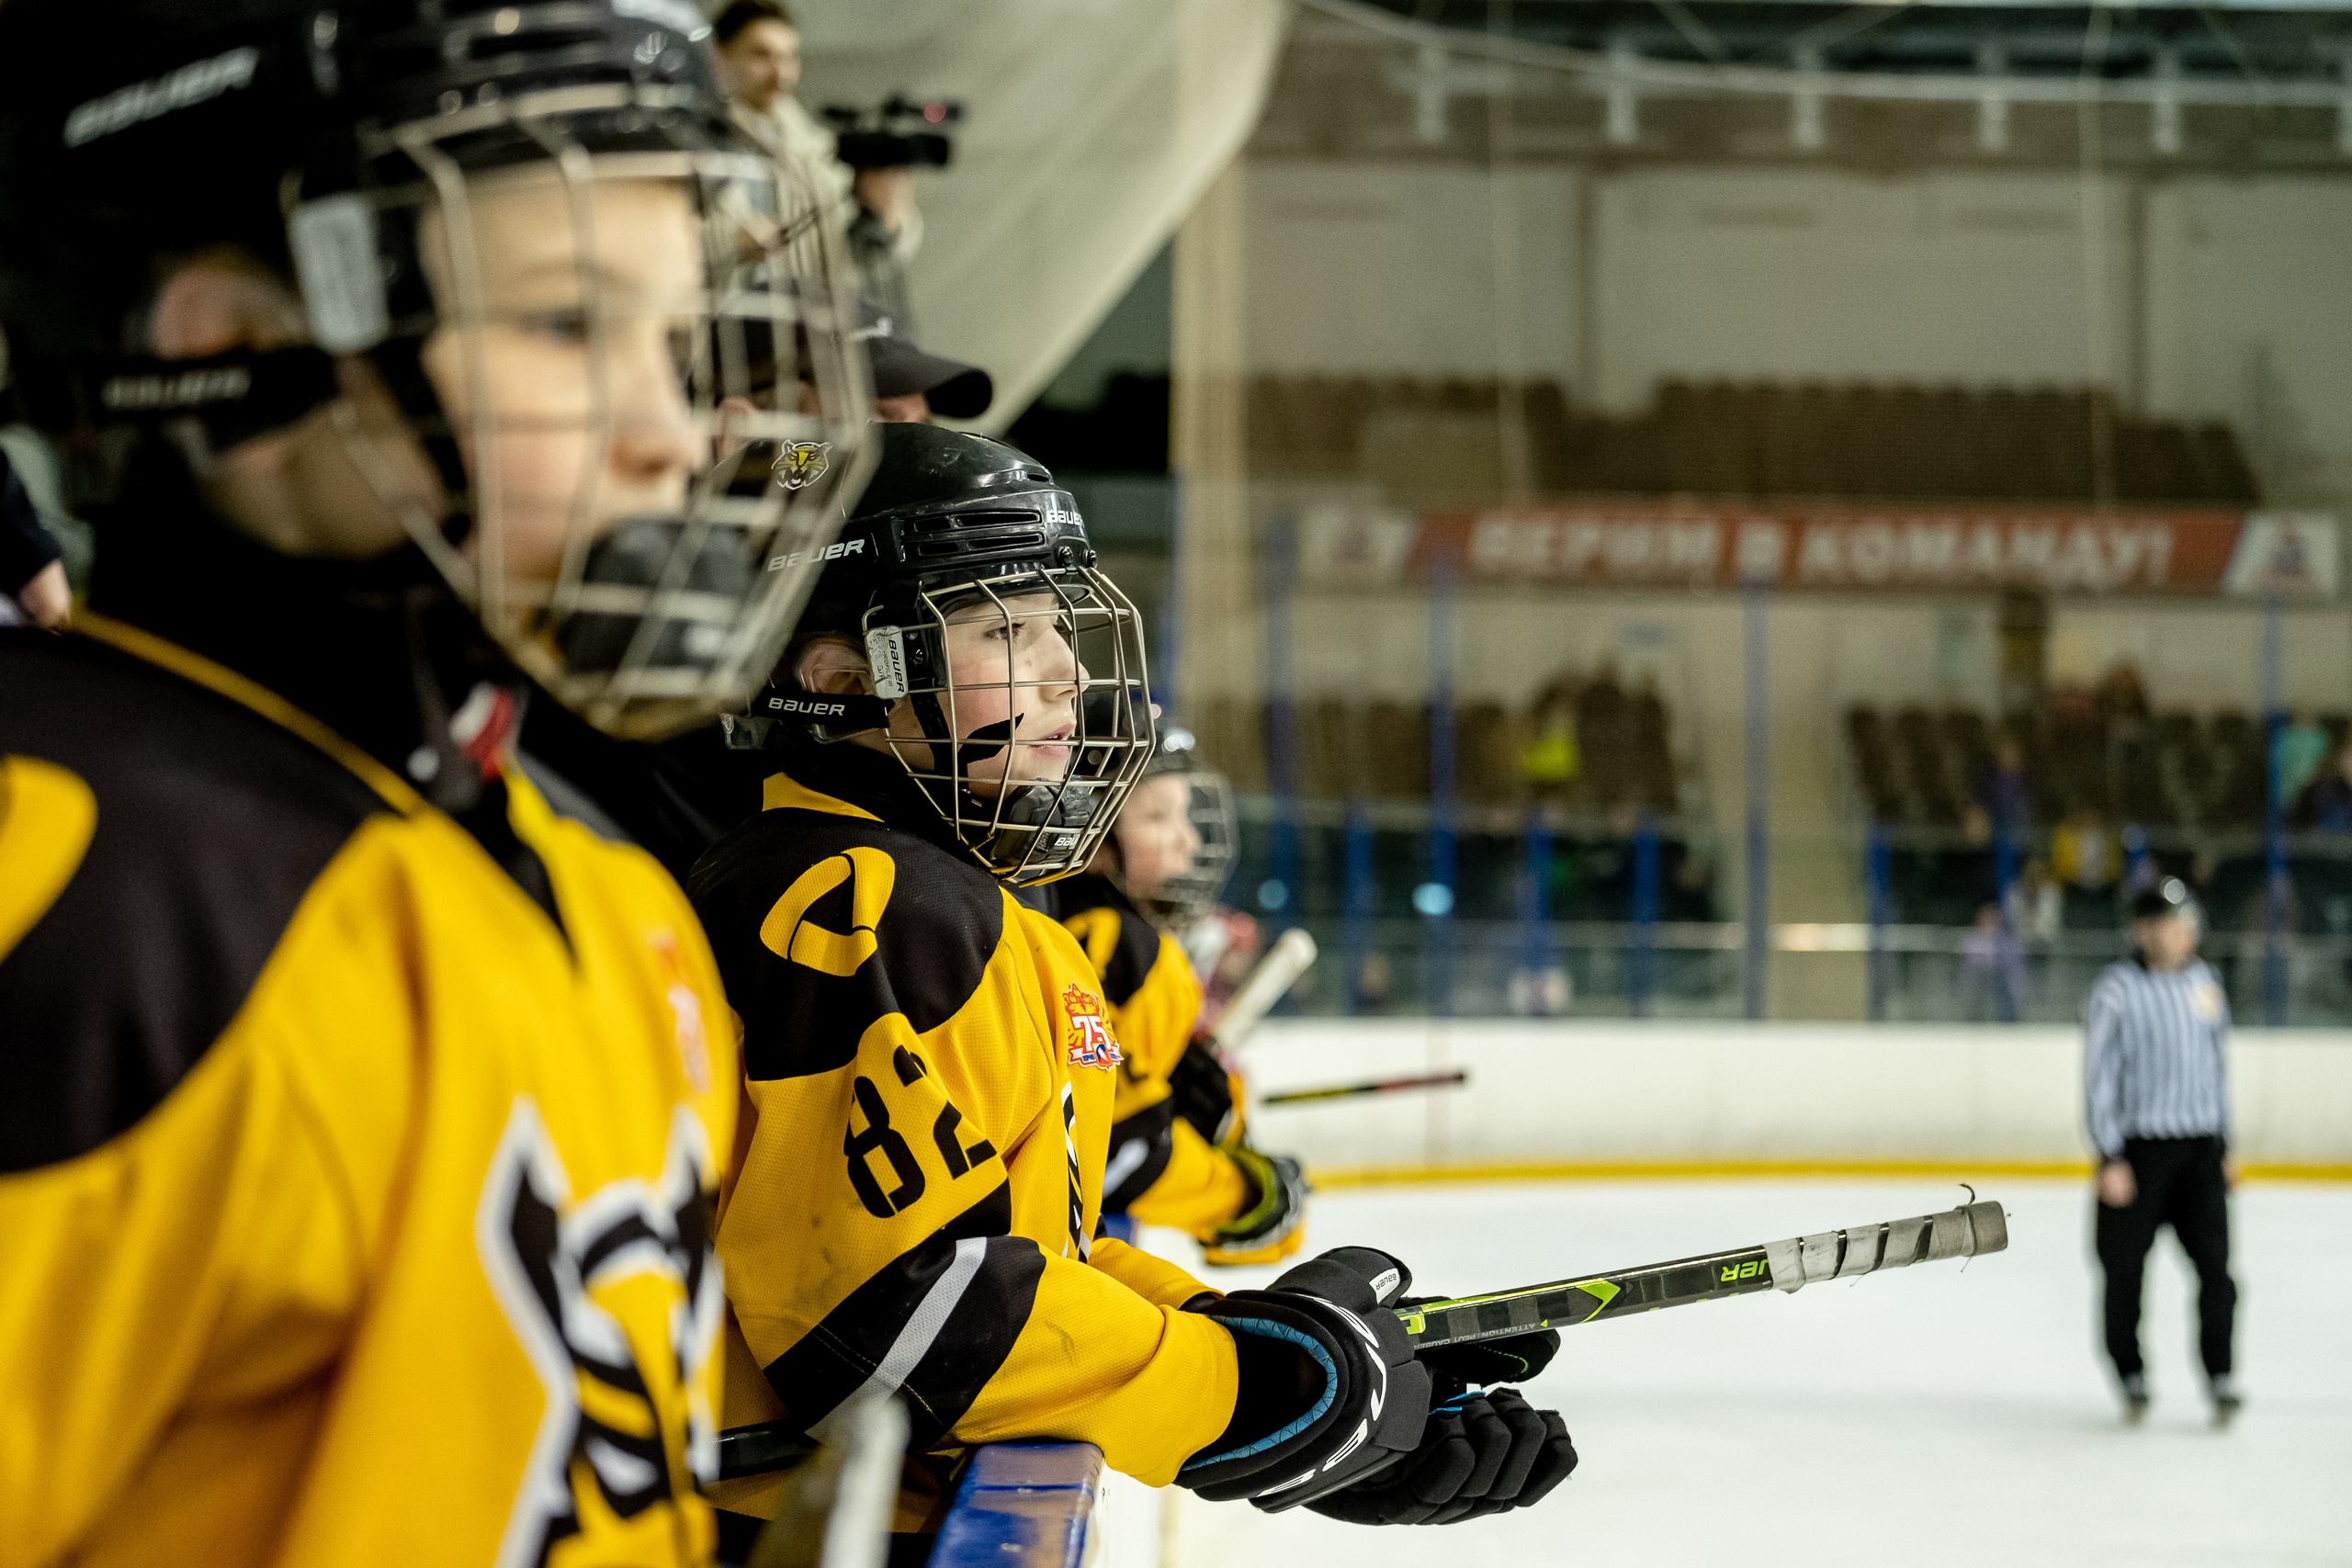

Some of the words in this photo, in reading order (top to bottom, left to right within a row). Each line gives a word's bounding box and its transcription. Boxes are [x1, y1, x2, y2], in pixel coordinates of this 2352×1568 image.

[1046, 510, 1084, 526] BAUE
[768, 539, 865, 571] BAUER
[888, 639, 905, 693] BAUER
[768, 697, 845, 716] BAUER
[1054, 837, 1078, 847] BAU
[1071, 1015, 1112, 1052] 75
[843, 1044, 998, 1218] 82
[1375, 1273, 1397, 1291] BAUER
[1454, 1334, 1476, 1343] PEUT
